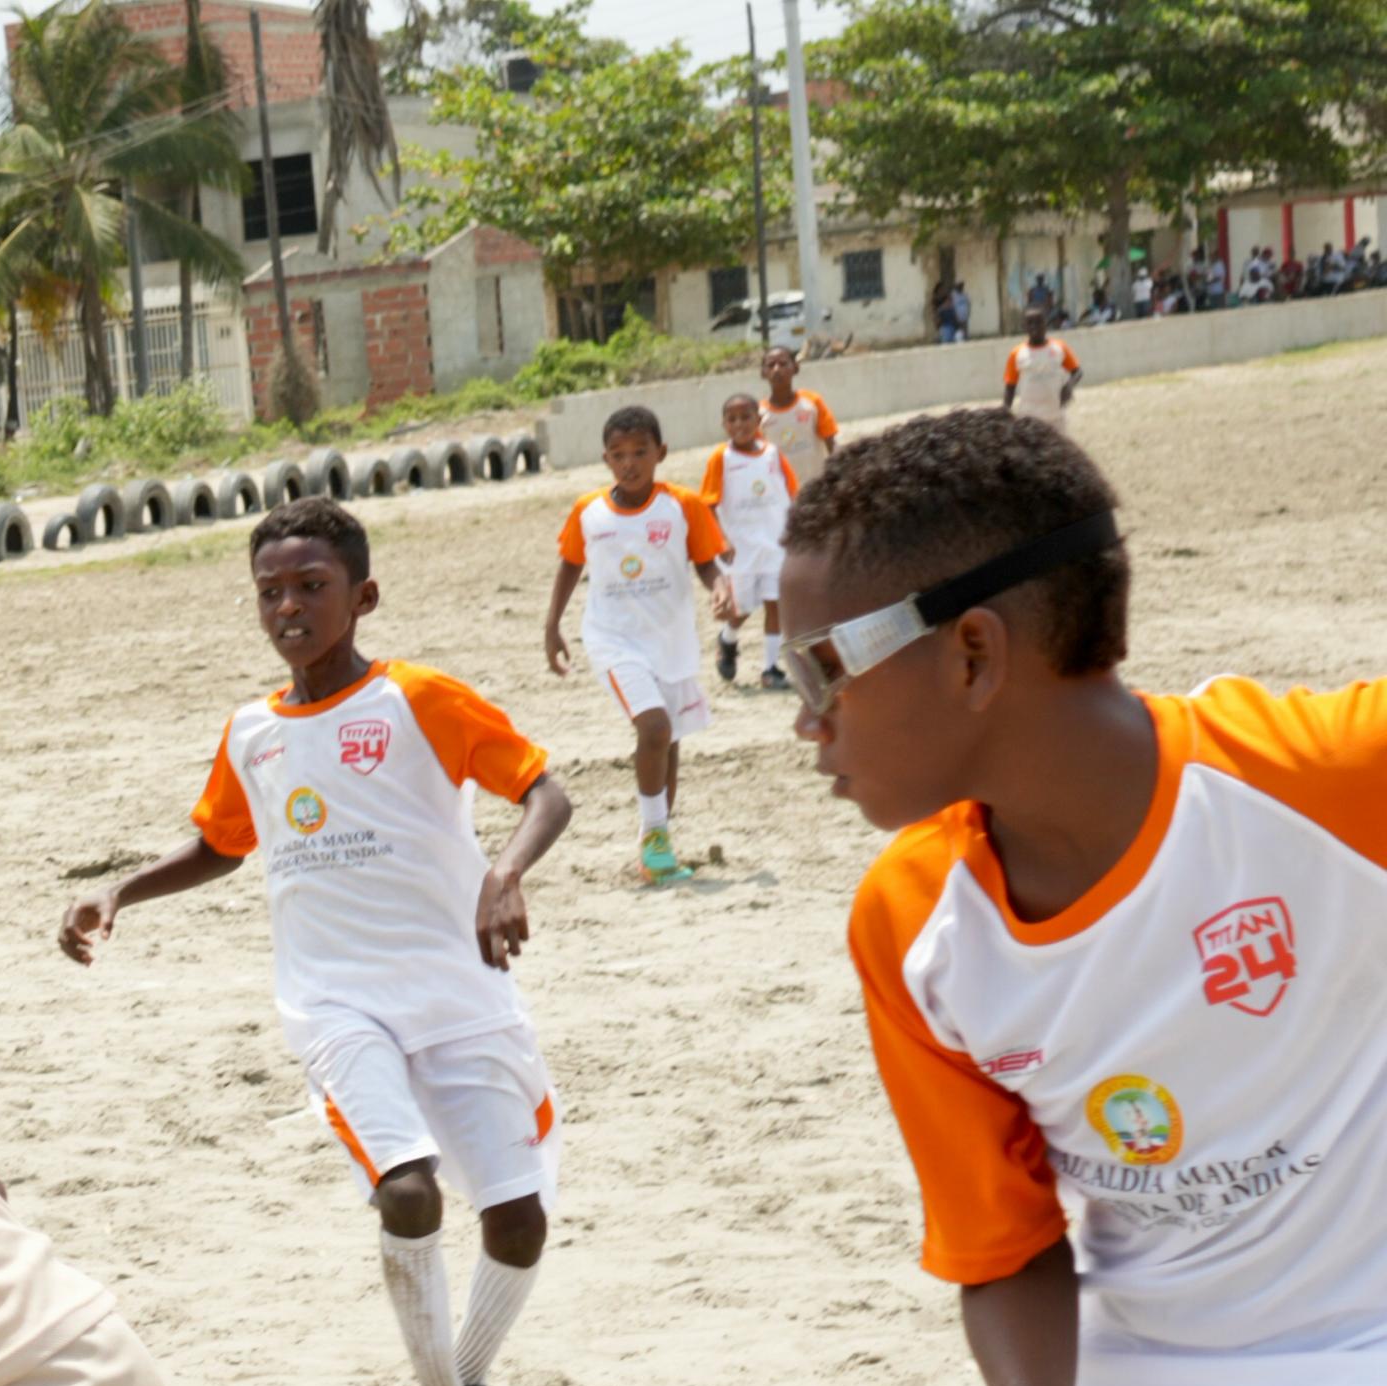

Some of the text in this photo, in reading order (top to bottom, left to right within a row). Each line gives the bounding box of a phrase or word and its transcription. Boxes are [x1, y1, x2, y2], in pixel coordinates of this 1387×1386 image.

[340, 739, 385, 764] 24
[322, 830, 375, 847] MAYOR
[1203, 932, 1297, 1006] 24
